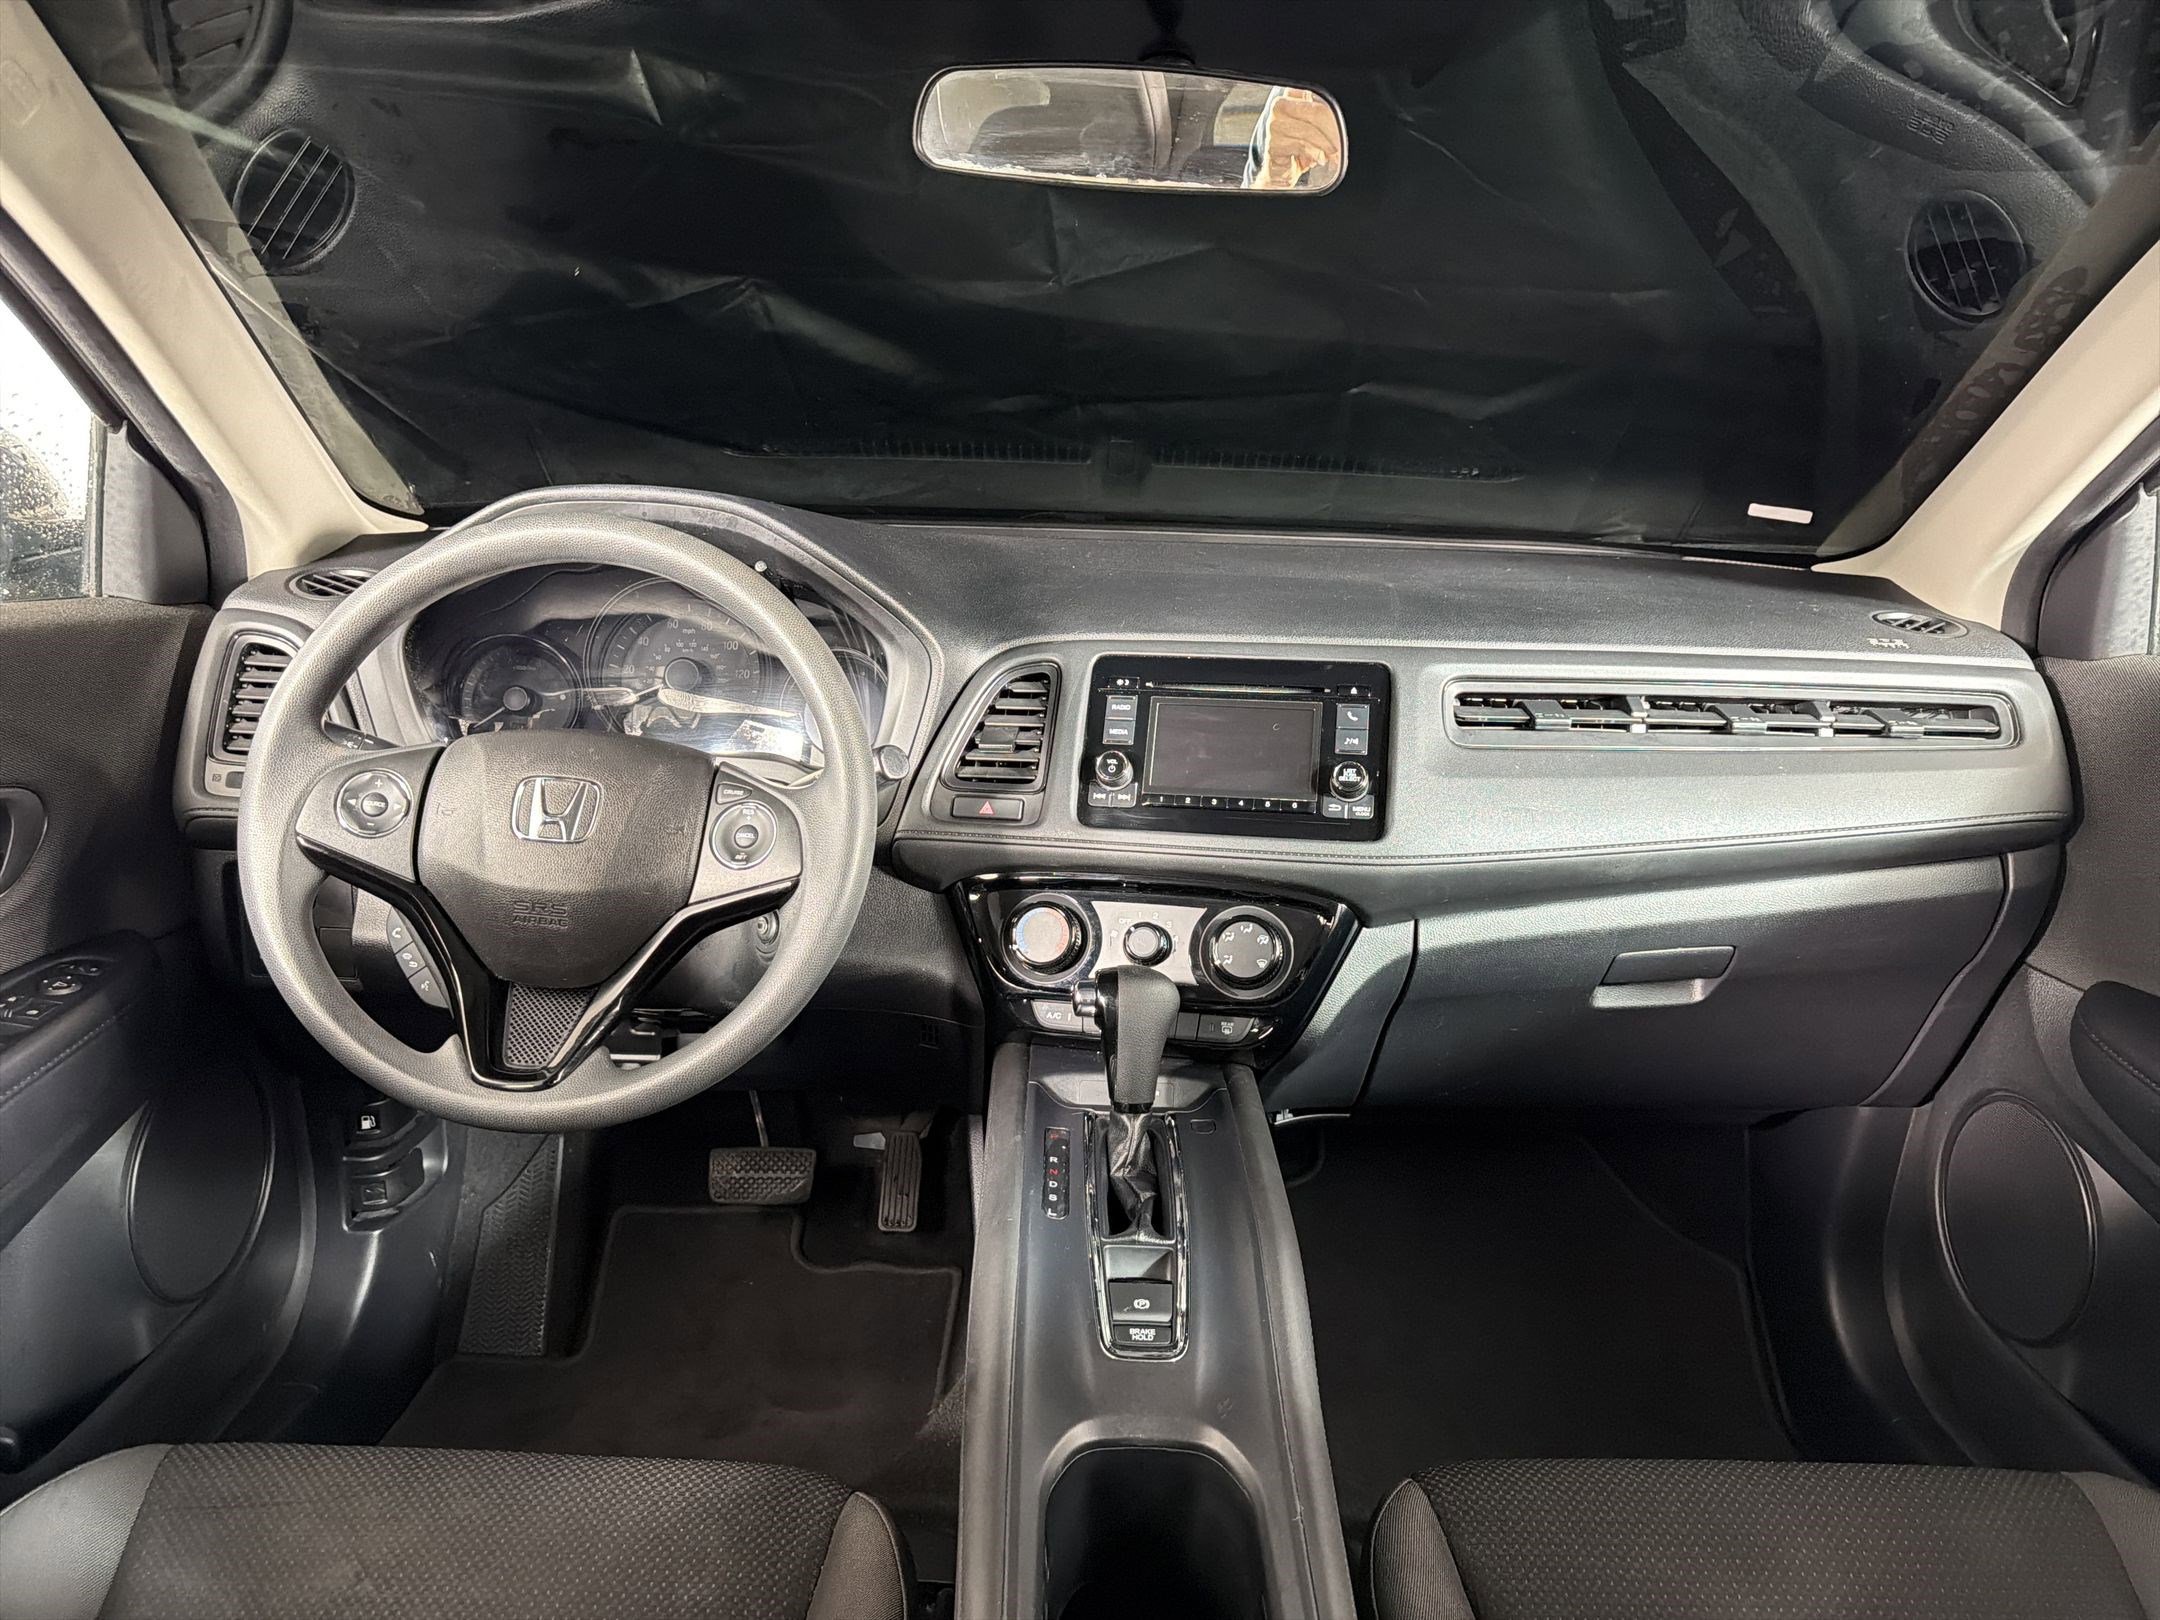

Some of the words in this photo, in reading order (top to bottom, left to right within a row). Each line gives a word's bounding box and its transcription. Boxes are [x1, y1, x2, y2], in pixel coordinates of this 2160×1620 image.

[638, 636, 649, 647] 40
[723, 640, 739, 651] 100
[735, 669, 750, 680] 120
[1109, 728, 1129, 736] MEDIA
[1211, 798, 1217, 806] 3
[512, 900, 569, 917] SRS
[512, 915, 569, 929] AIRBAG
[1047, 1208, 1057, 1217] L
[1129, 1328, 1156, 1336] BRAKE
